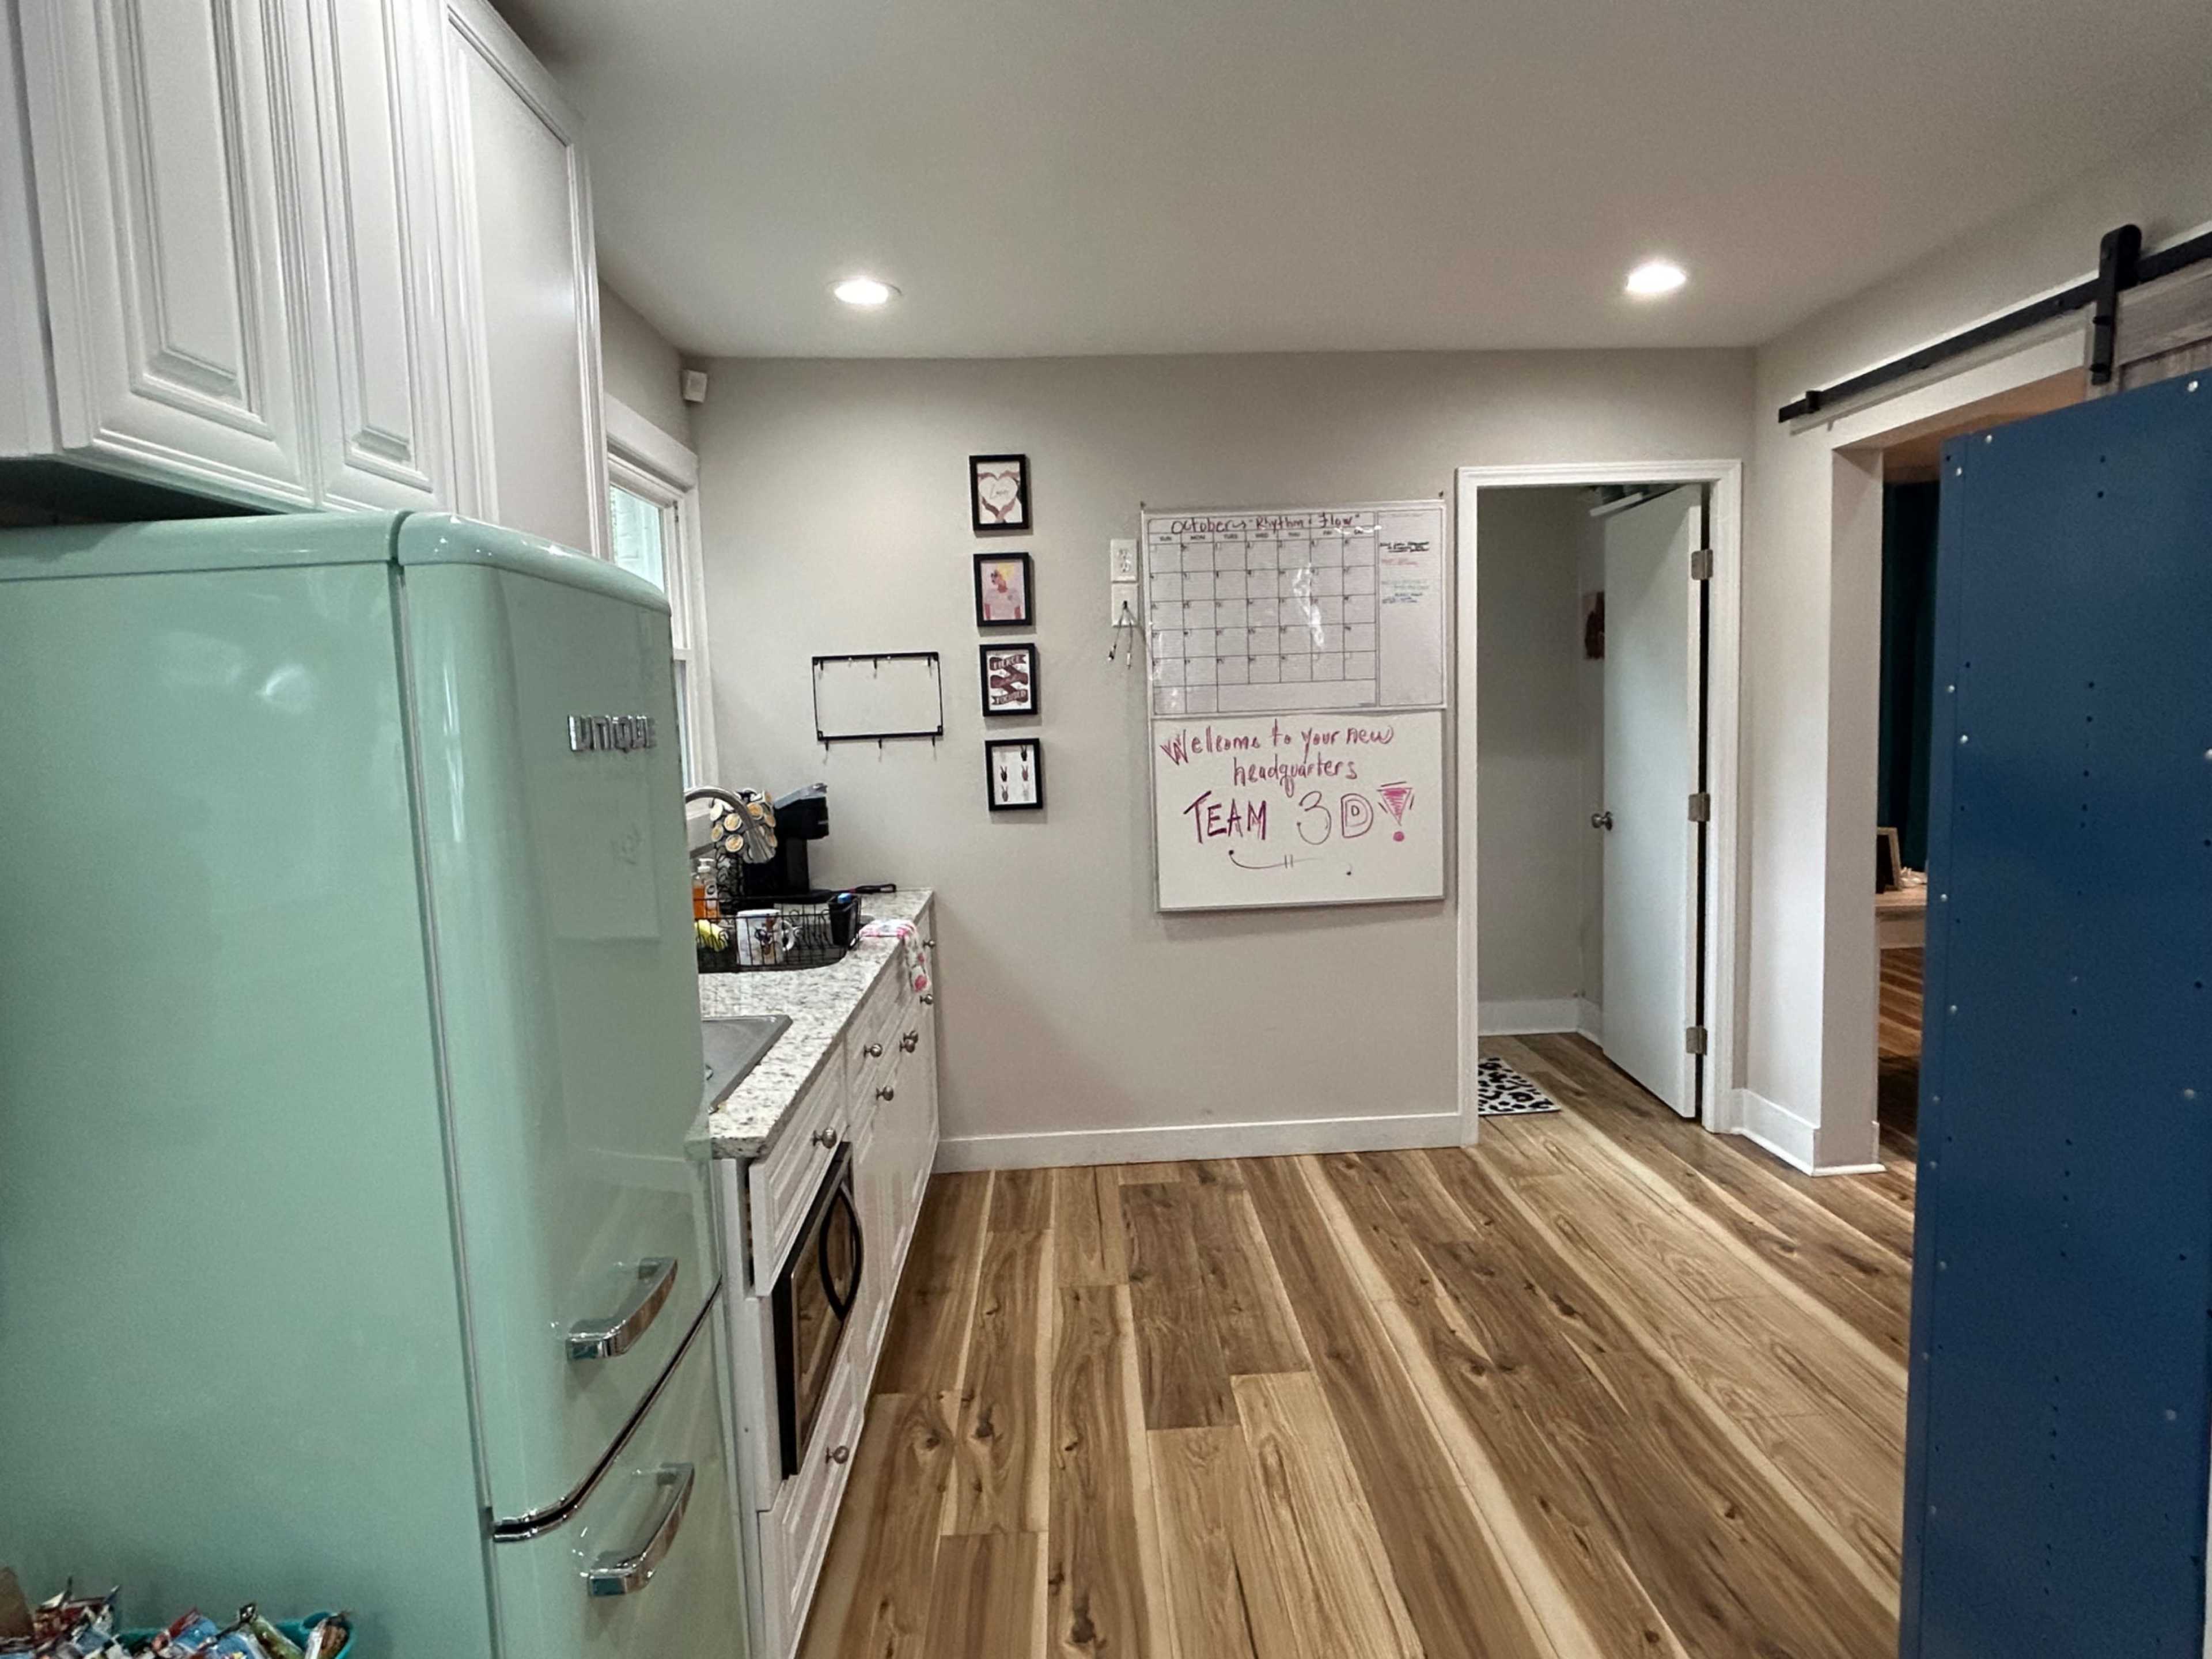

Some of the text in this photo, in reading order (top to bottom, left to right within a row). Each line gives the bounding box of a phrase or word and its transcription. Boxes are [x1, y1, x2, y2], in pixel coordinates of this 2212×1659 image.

[1160, 718, 1395, 766] Welcome to your new
[1233, 751, 1358, 798] headquarters
[1183, 790, 1267, 844] TEAM
